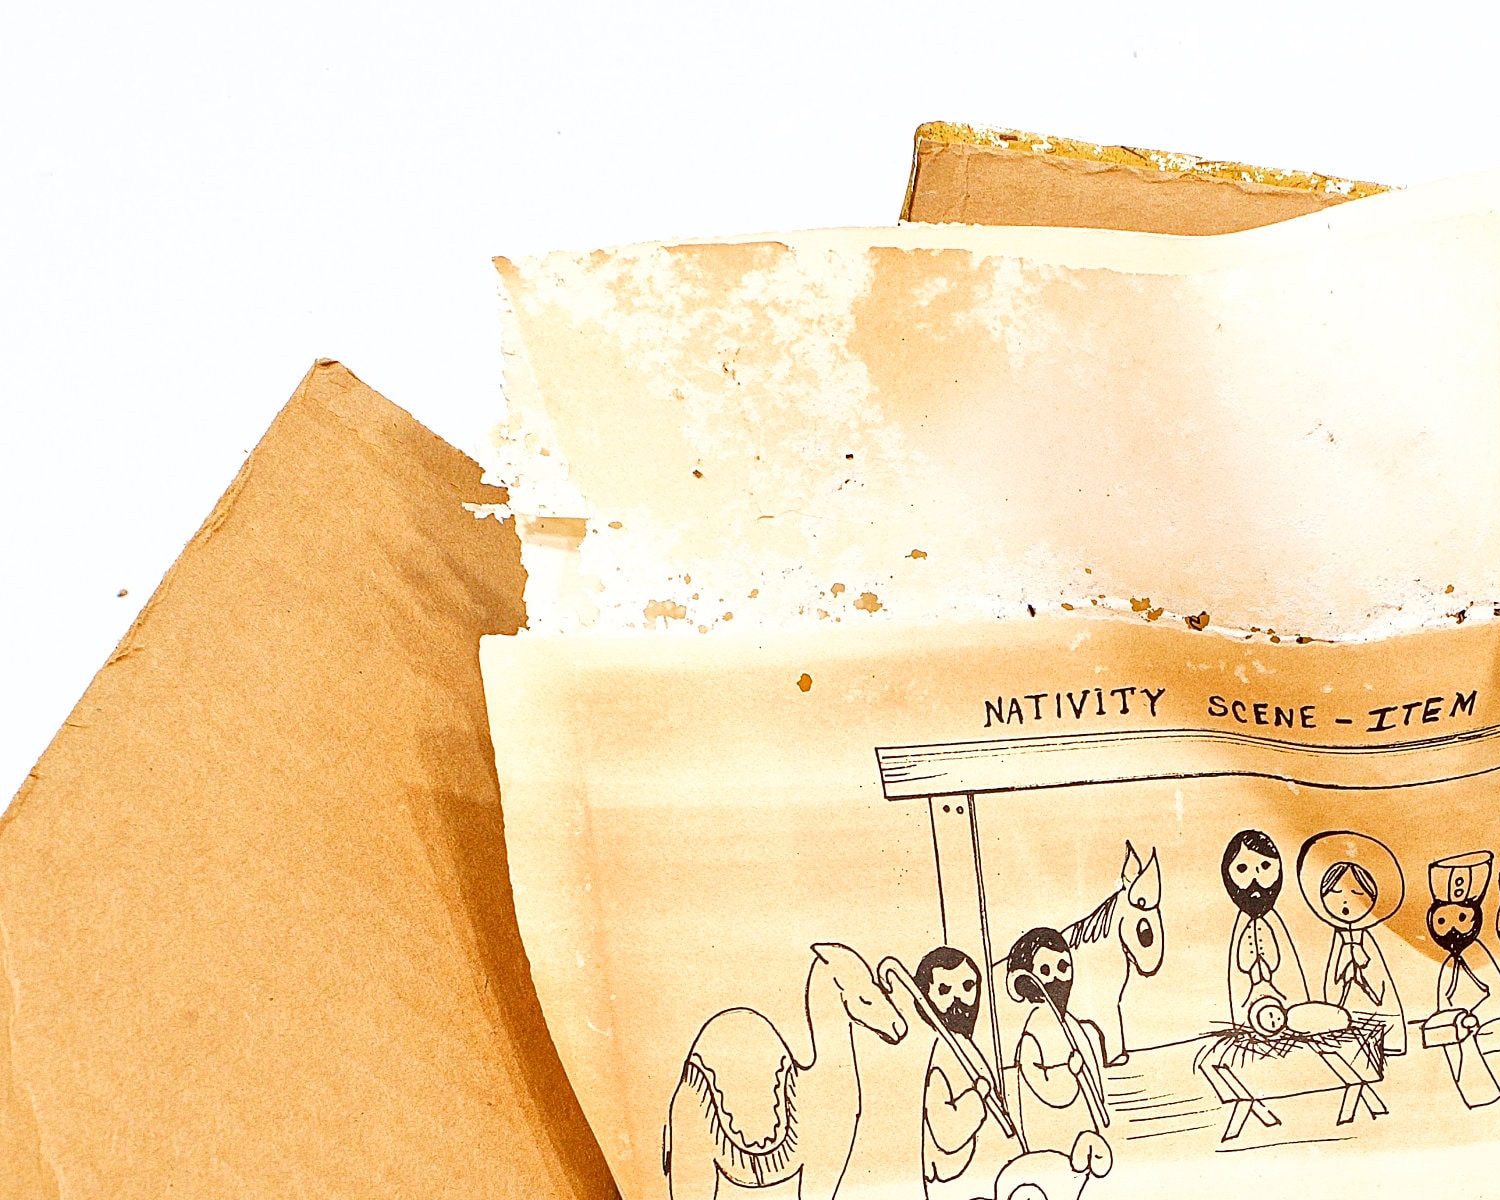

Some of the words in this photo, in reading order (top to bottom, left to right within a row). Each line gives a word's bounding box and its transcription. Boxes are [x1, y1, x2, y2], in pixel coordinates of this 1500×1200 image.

[983, 687, 1166, 728] NATIVITY
[1207, 695, 1317, 730] SCENE
[1367, 689, 1477, 733] ITEM
